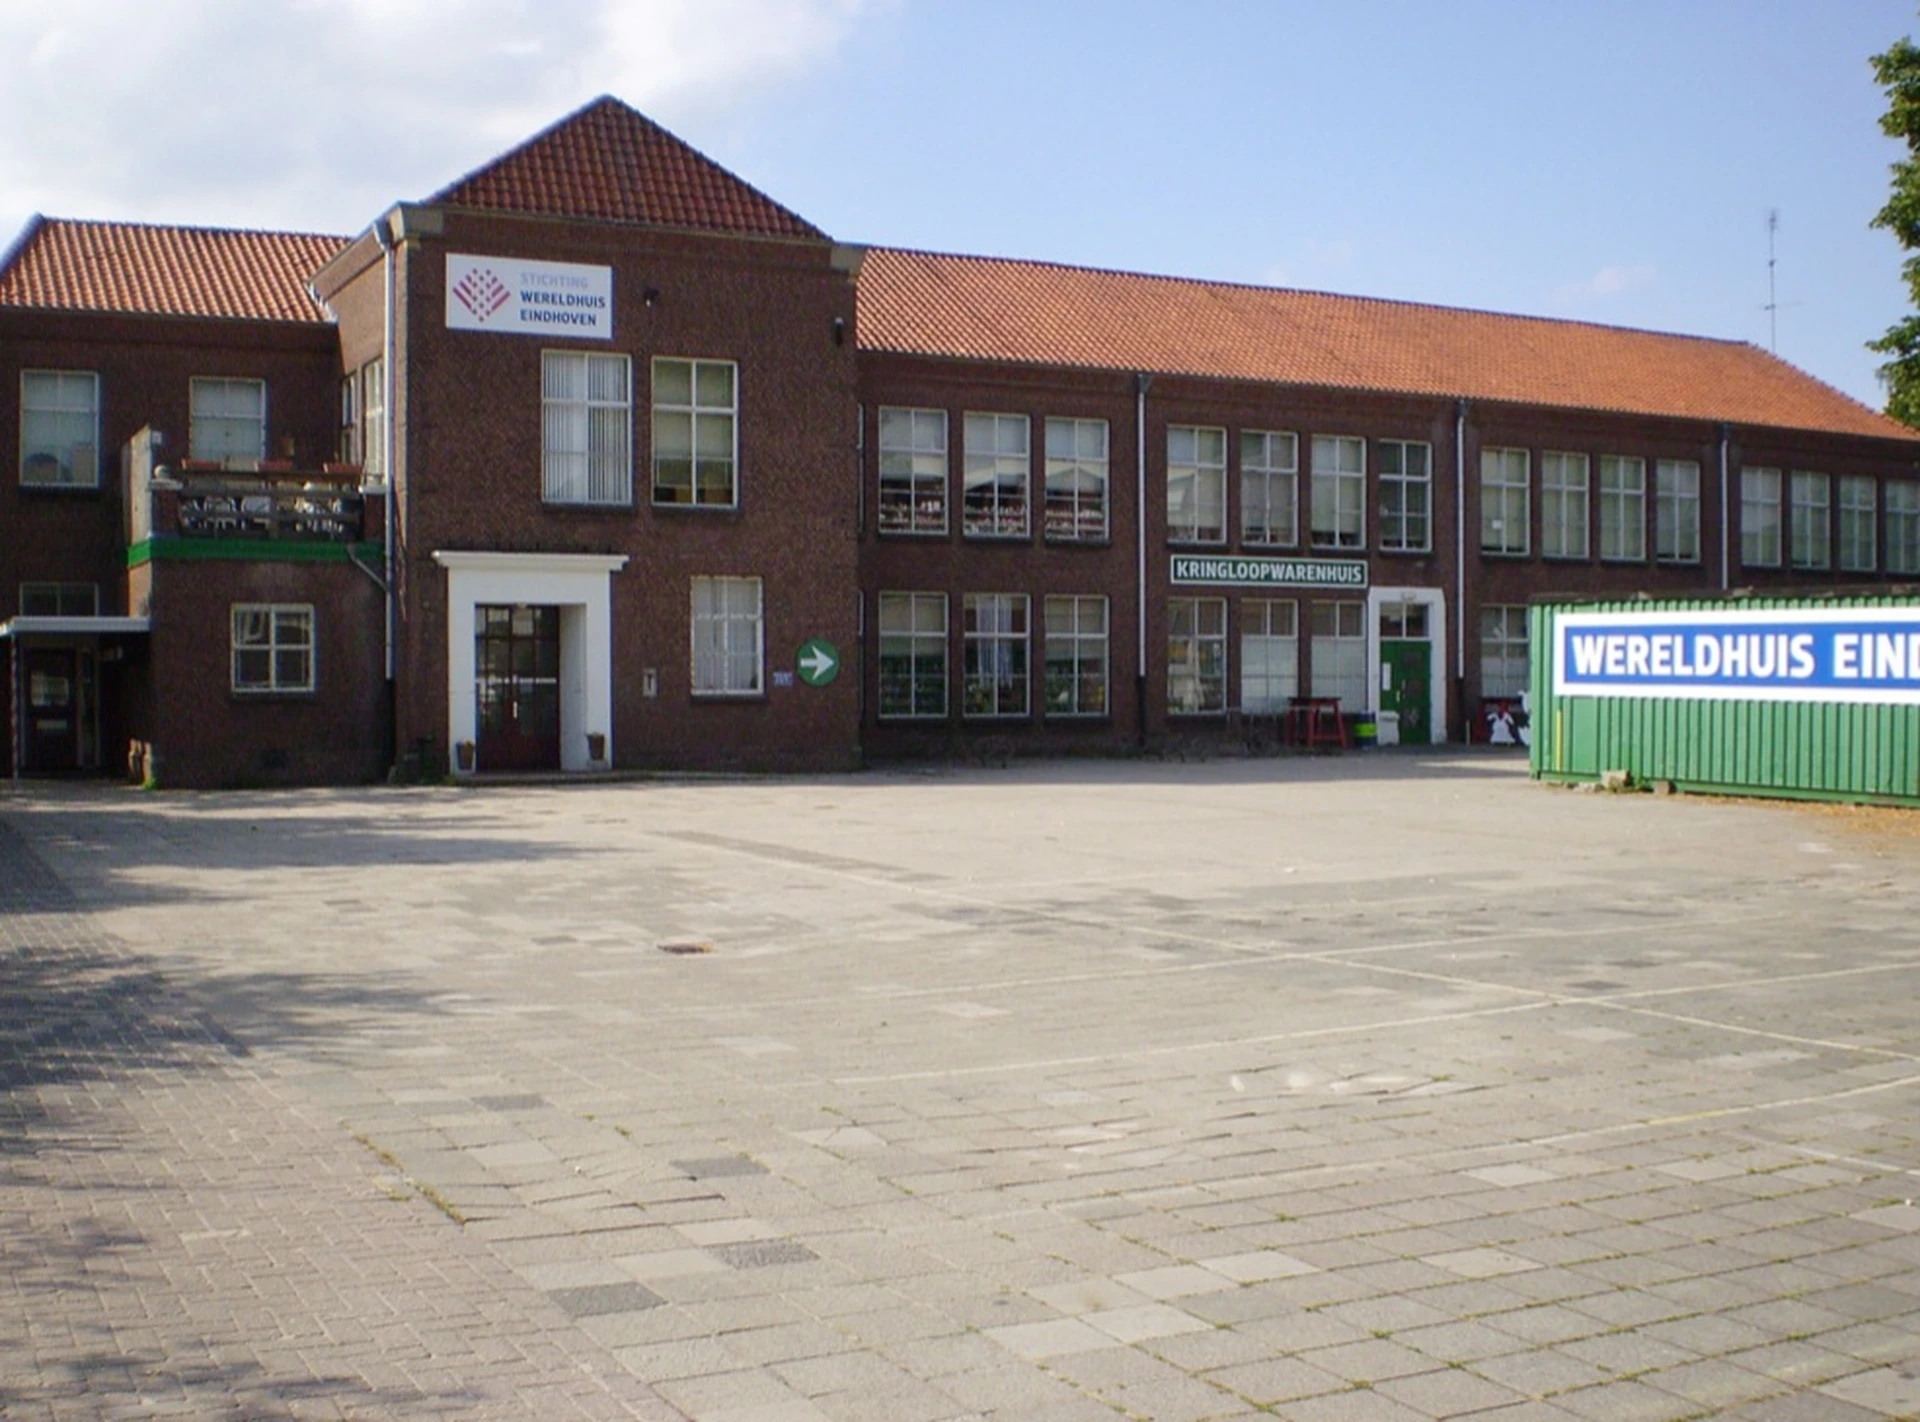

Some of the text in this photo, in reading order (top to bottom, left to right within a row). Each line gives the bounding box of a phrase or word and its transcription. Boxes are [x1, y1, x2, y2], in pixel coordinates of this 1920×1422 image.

[520, 271, 588, 289] STICHTING
[520, 290, 606, 309] WERELDHUIS
[520, 309, 597, 326] EINDHOVEN
[1176, 559, 1362, 582] KRINGLOOPWARENHUIS
[1571, 633, 1816, 678] WERELDHUIS
